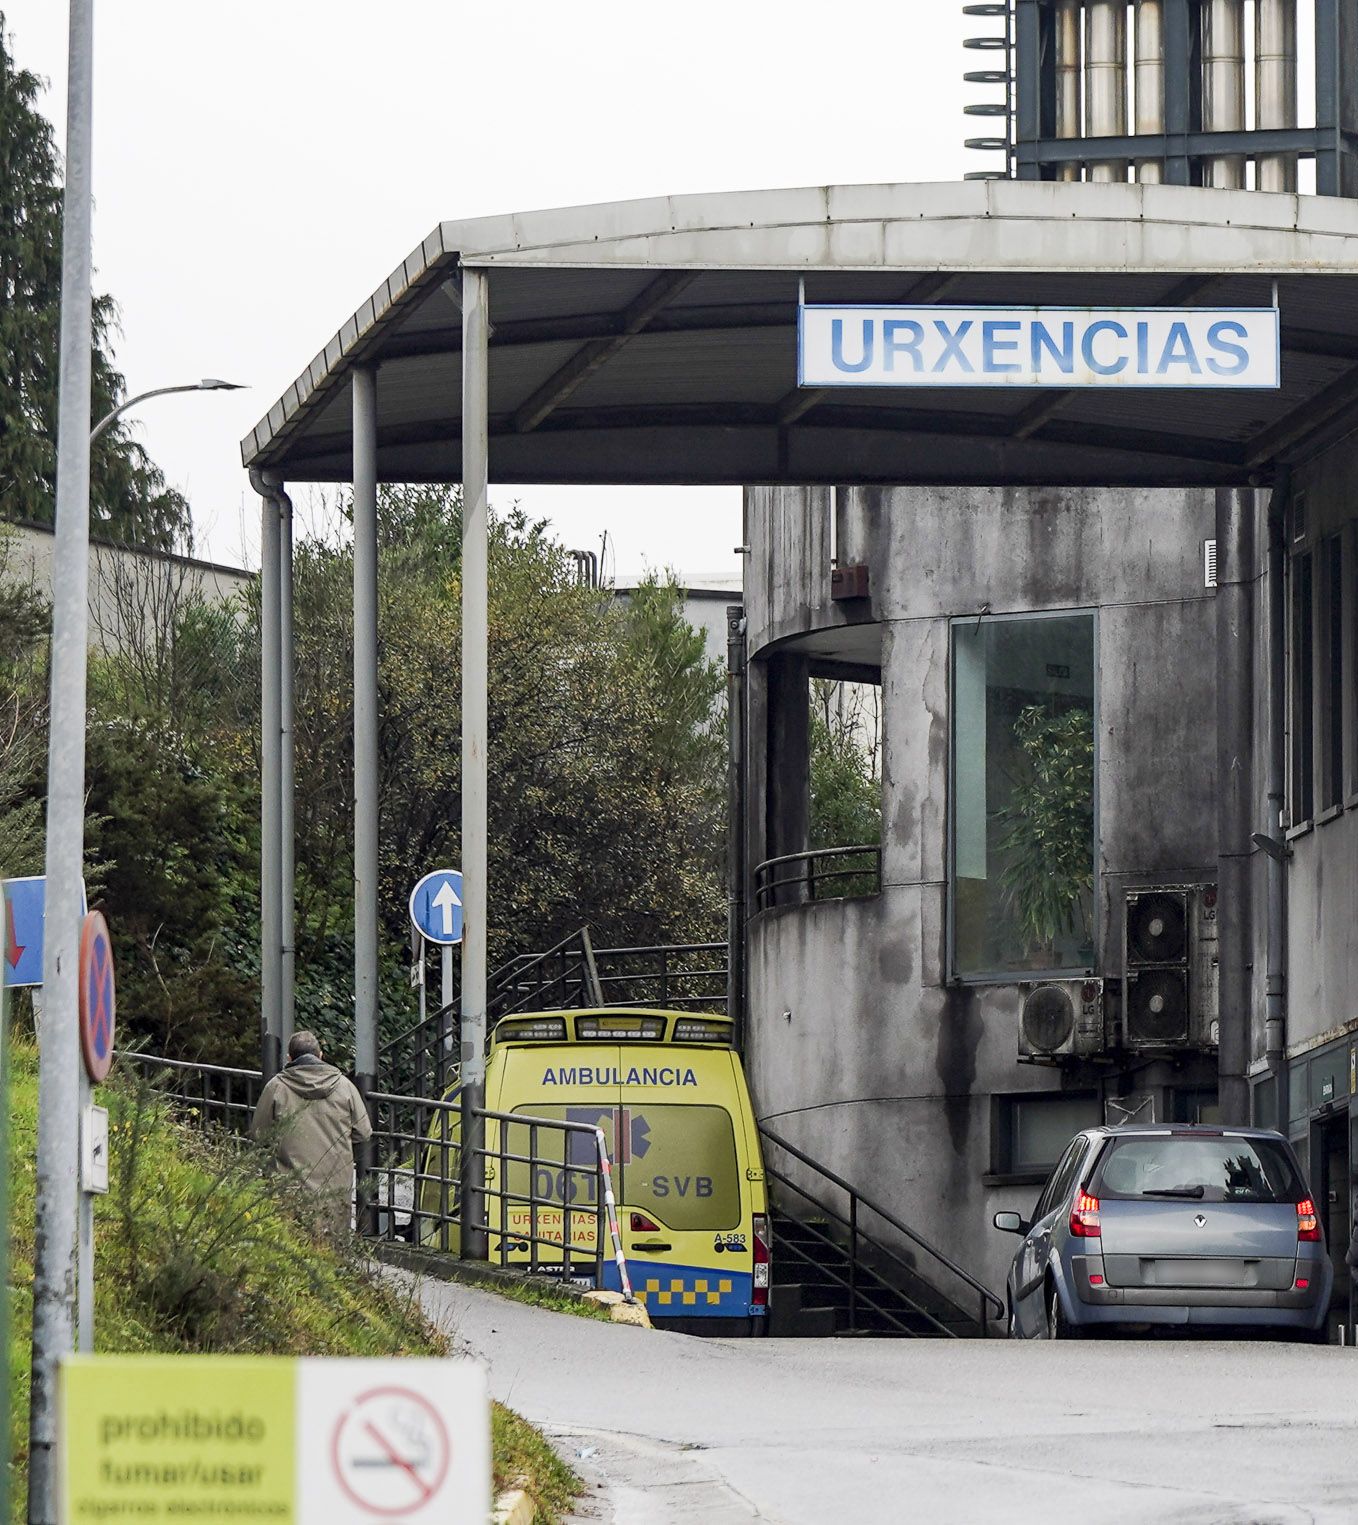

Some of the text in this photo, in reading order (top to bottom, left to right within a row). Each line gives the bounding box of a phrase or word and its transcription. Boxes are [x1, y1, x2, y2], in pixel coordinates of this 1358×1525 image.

[831, 318, 1250, 376] URXENCIAS
[1204, 911, 1215, 920] LG
[1083, 1005, 1095, 1015] LG
[542, 1067, 698, 1086] AMBULANCIA
[652, 1175, 714, 1198] SVB
[714, 1233, 746, 1244] A-583
[99, 1411, 265, 1446] prohibido
